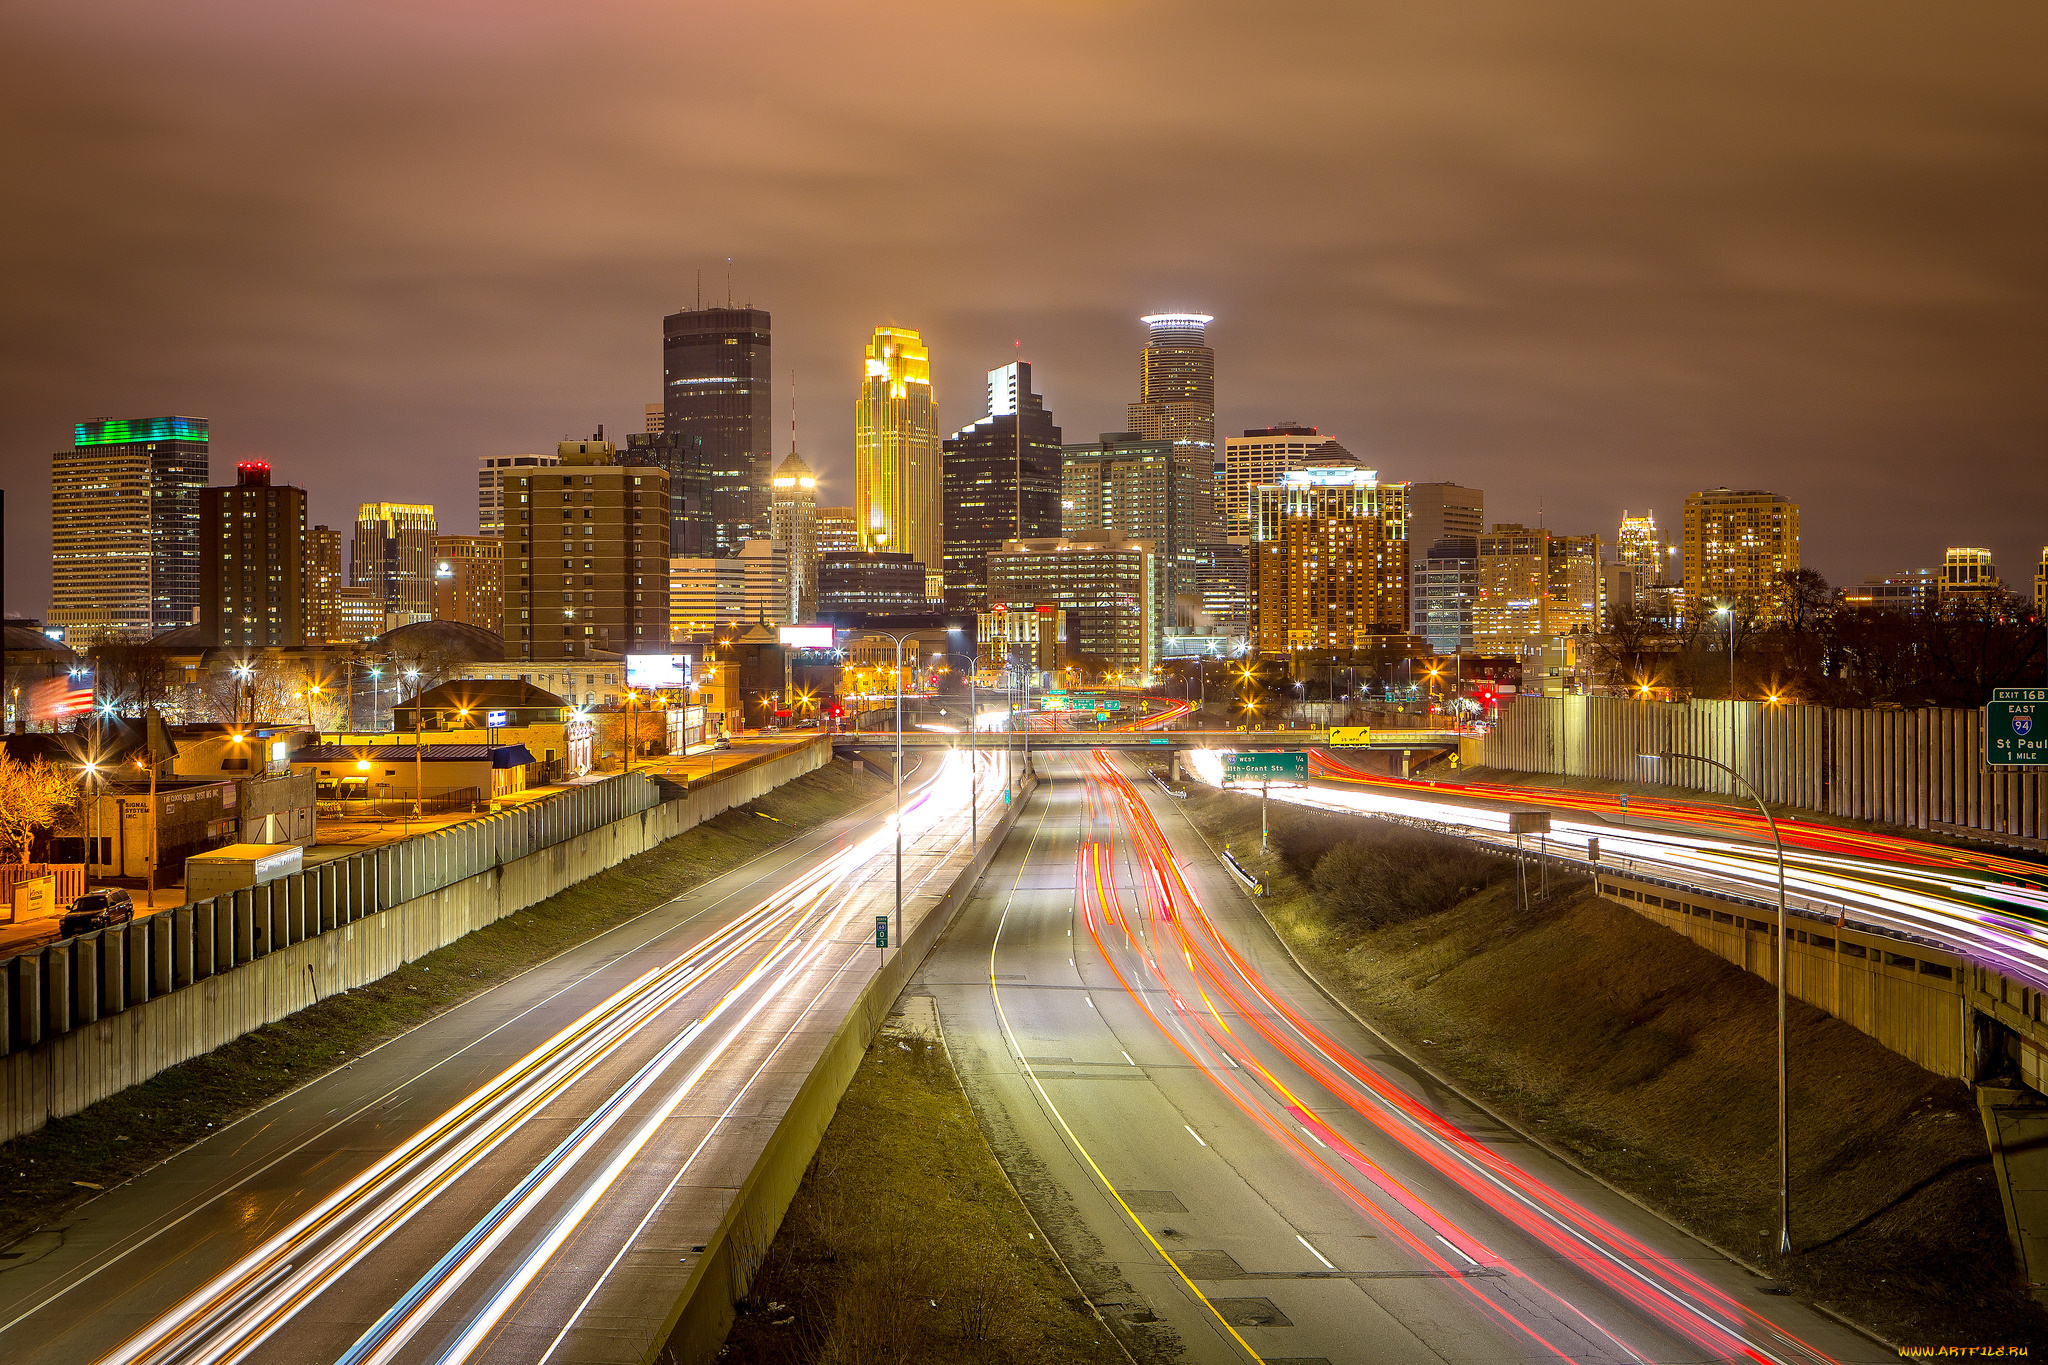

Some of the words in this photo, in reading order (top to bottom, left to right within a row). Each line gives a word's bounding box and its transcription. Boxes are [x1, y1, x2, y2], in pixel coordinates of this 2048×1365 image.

[1999, 691, 2019, 699] EXIT
[2023, 690, 2045, 700] 16B
[2008, 705, 2035, 713] EAST
[2015, 721, 2029, 731] 94
[1997, 739, 2011, 749] St
[2018, 739, 2048, 749] Paul
[2008, 751, 2011, 760] 1
[2016, 752, 2037, 760] MILE
